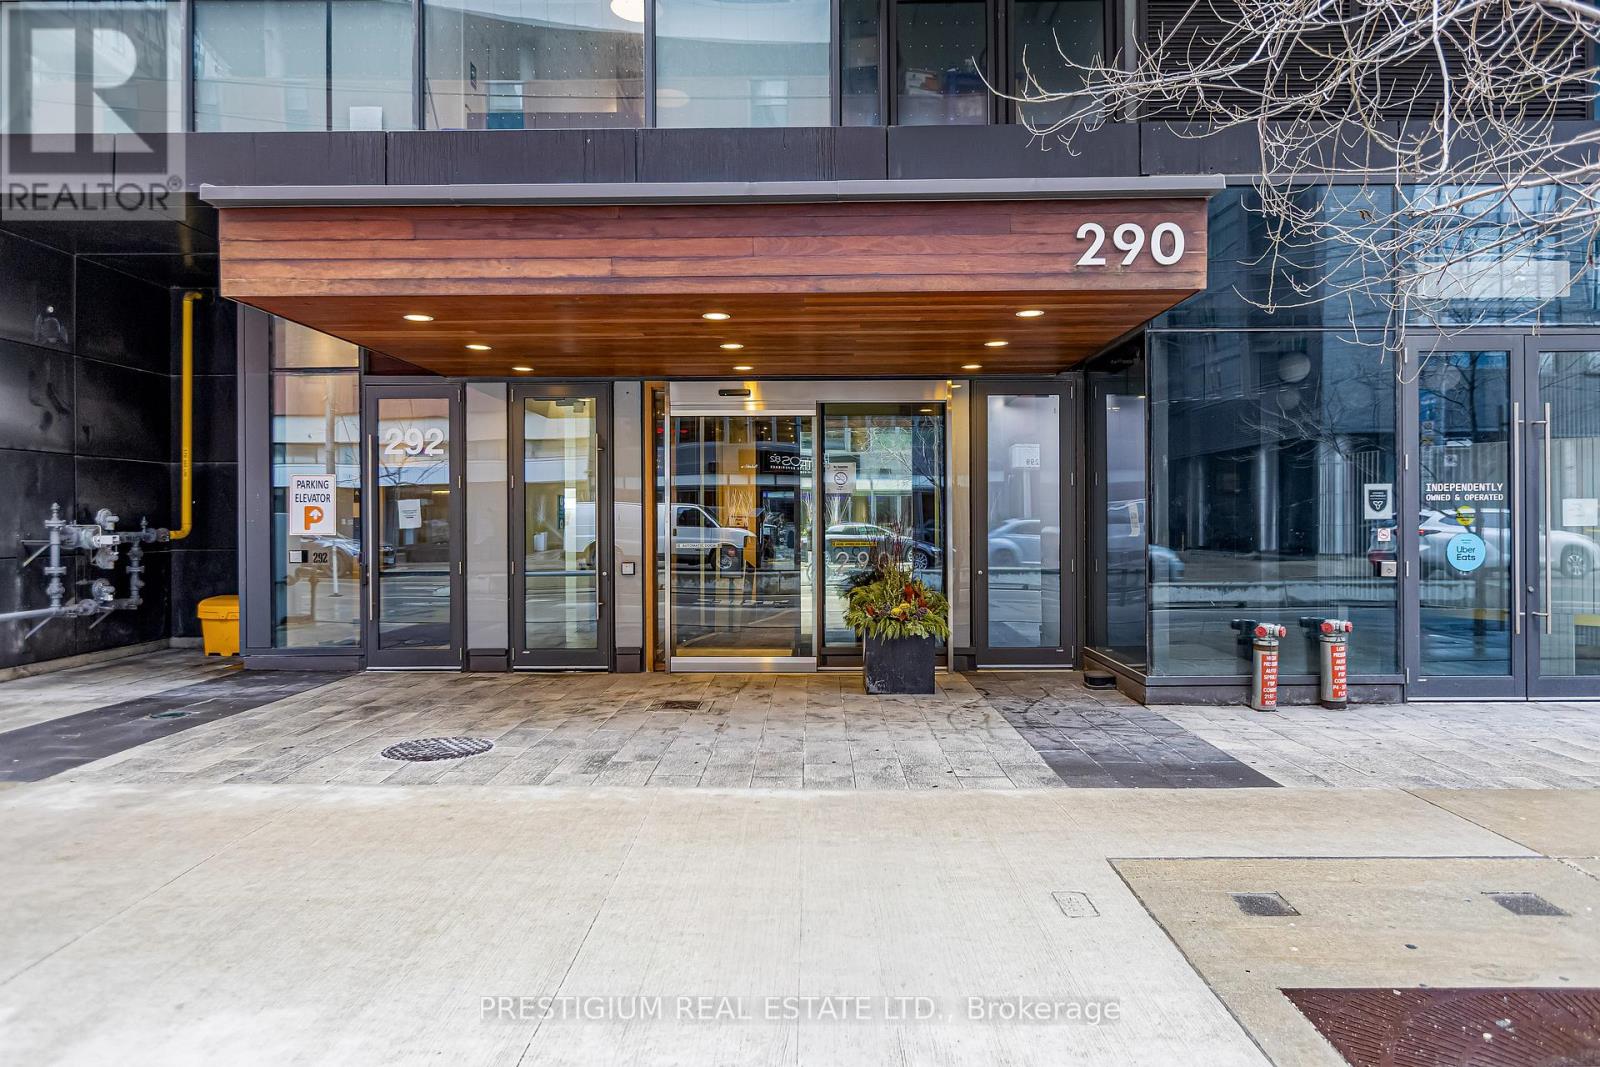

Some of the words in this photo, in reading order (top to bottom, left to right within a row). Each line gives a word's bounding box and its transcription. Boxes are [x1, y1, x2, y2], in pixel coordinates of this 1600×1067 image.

[1075, 221, 1185, 266] 290
[383, 427, 444, 456] 292
[296, 480, 330, 490] PARKING
[1425, 482, 1504, 492] INDEPENDENTLY
[294, 493, 331, 503] ELEVATOR
[1425, 493, 1451, 501] OWNED
[1464, 493, 1504, 501] OPERATED
[1456, 545, 1476, 554] Uber
[312, 552, 328, 564] 292
